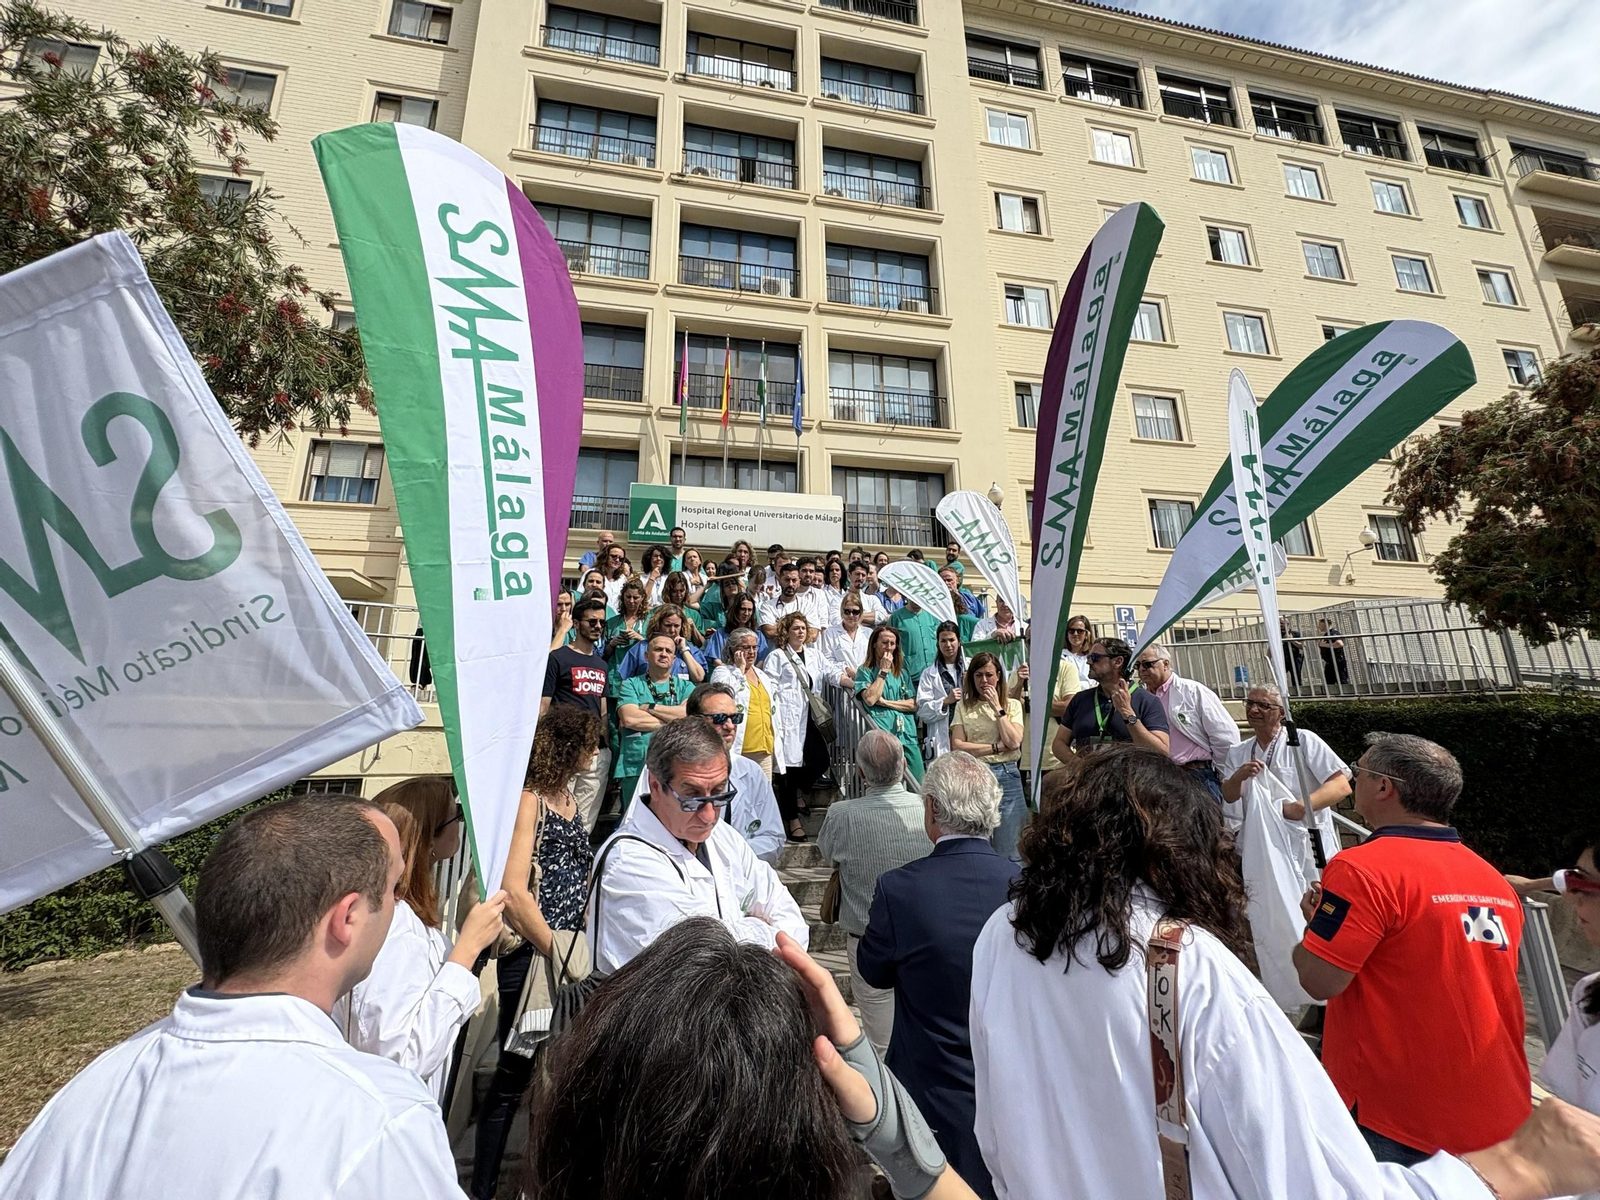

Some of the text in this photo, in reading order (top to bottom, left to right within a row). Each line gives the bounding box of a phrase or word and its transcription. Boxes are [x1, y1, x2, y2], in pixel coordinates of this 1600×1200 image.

[1061, 260, 1108, 443] Málaga
[1275, 349, 1398, 458] Málaga
[487, 383, 533, 599] Málaga
[681, 506, 842, 523] Hospital Regional Universitario de Málaga
[681, 520, 756, 532] Hospital General
[1120, 608, 1130, 621] P
